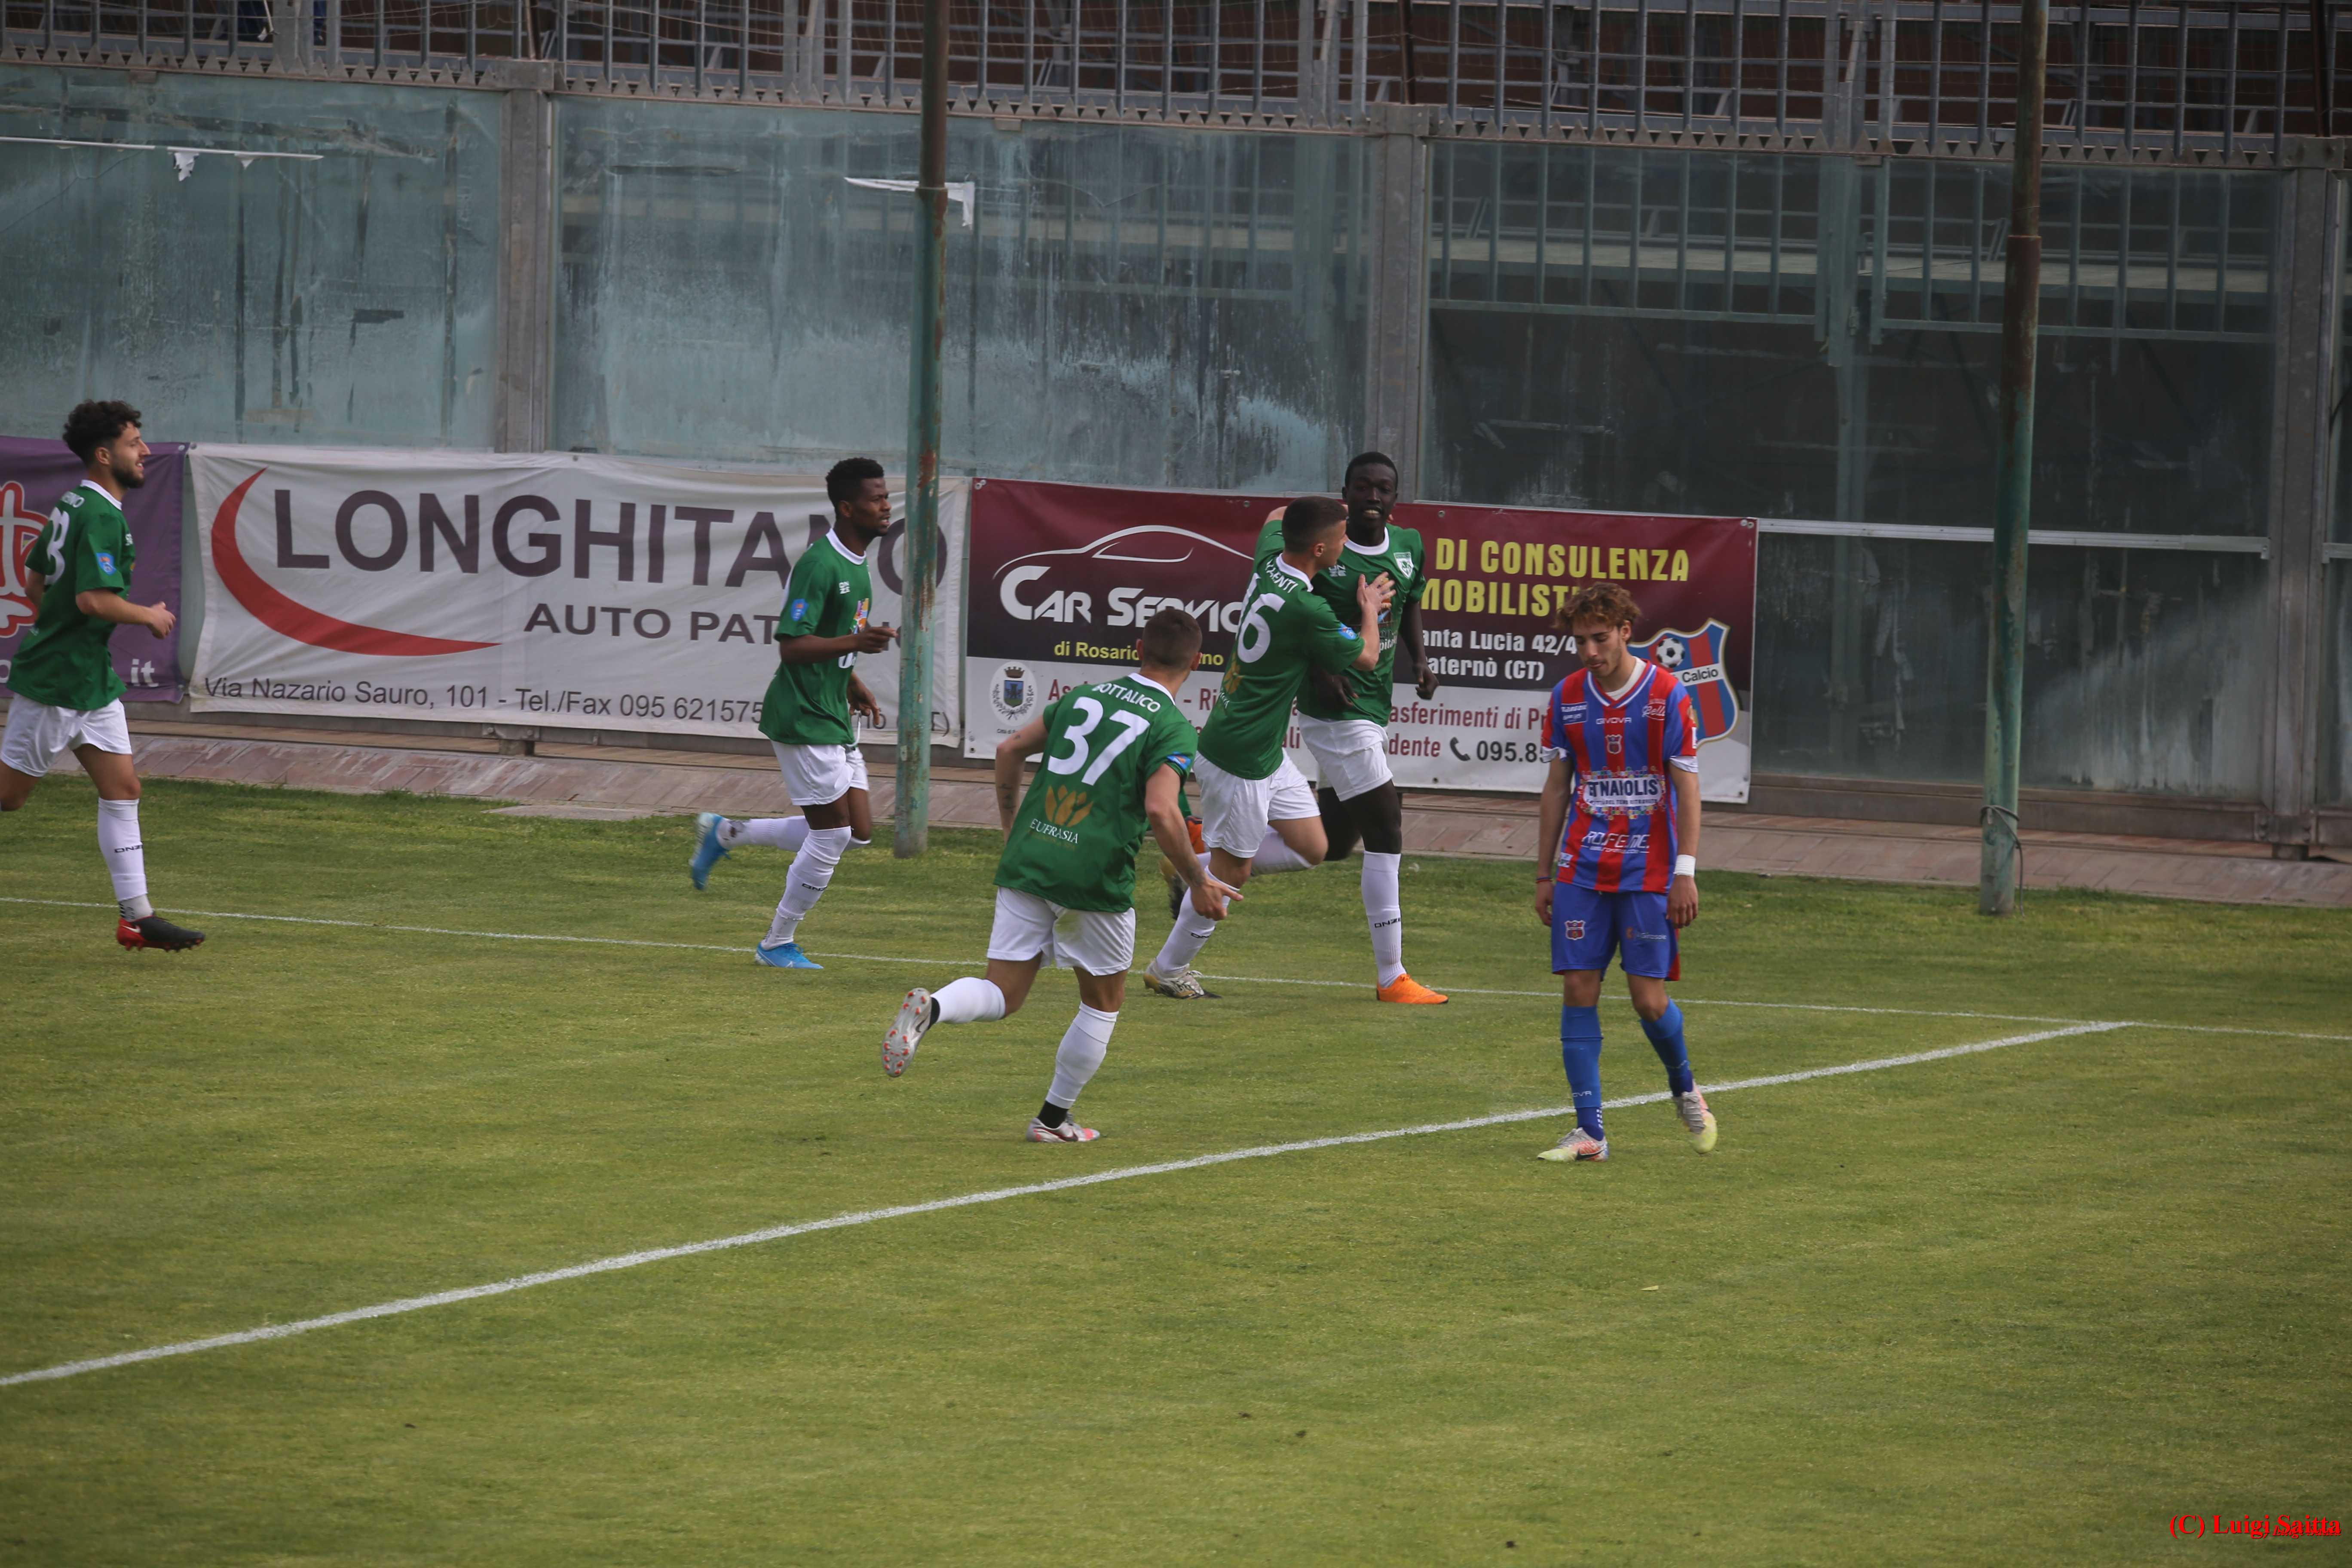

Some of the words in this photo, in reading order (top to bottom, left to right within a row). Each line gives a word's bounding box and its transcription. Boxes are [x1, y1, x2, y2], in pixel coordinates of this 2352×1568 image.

[1436, 538, 1467, 571] DI
[1481, 540, 1689, 581] CONSULENZA
[524, 603, 671, 638] AUTO
[1054, 641, 1070, 656] di
[1423, 630, 1462, 648] anta
[1470, 631, 1525, 652] Lucia
[1425, 657, 1498, 678] aternò
[1505, 660, 1545, 680] (CT)
[1682, 668, 1718, 683] Calcio
[205, 678, 242, 698] Via
[253, 678, 345, 702] Nazario
[355, 681, 434, 709] Sauro,
[447, 685, 487, 708] 101
[517, 688, 612, 716] Tel./Fax
[619, 694, 665, 719] 095
[1389, 702, 1499, 728] asferimenti
[1505, 707, 1521, 729] di
[1047, 696, 1151, 786] 37
[1029, 818, 1079, 844] EUFRASIA
